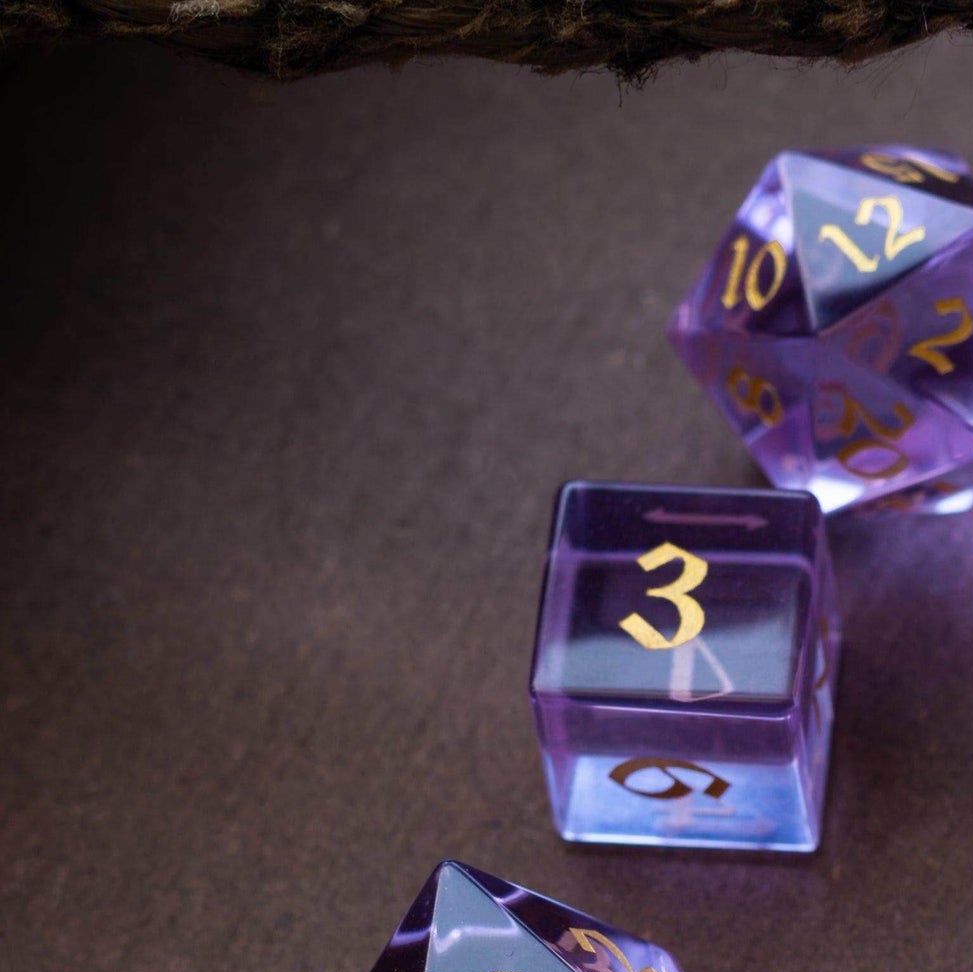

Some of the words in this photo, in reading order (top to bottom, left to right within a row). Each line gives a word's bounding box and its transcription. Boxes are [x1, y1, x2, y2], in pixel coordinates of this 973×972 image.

[818, 195, 926, 273] 12
[720, 235, 788, 312] 10
[618, 541, 709, 650] 3
